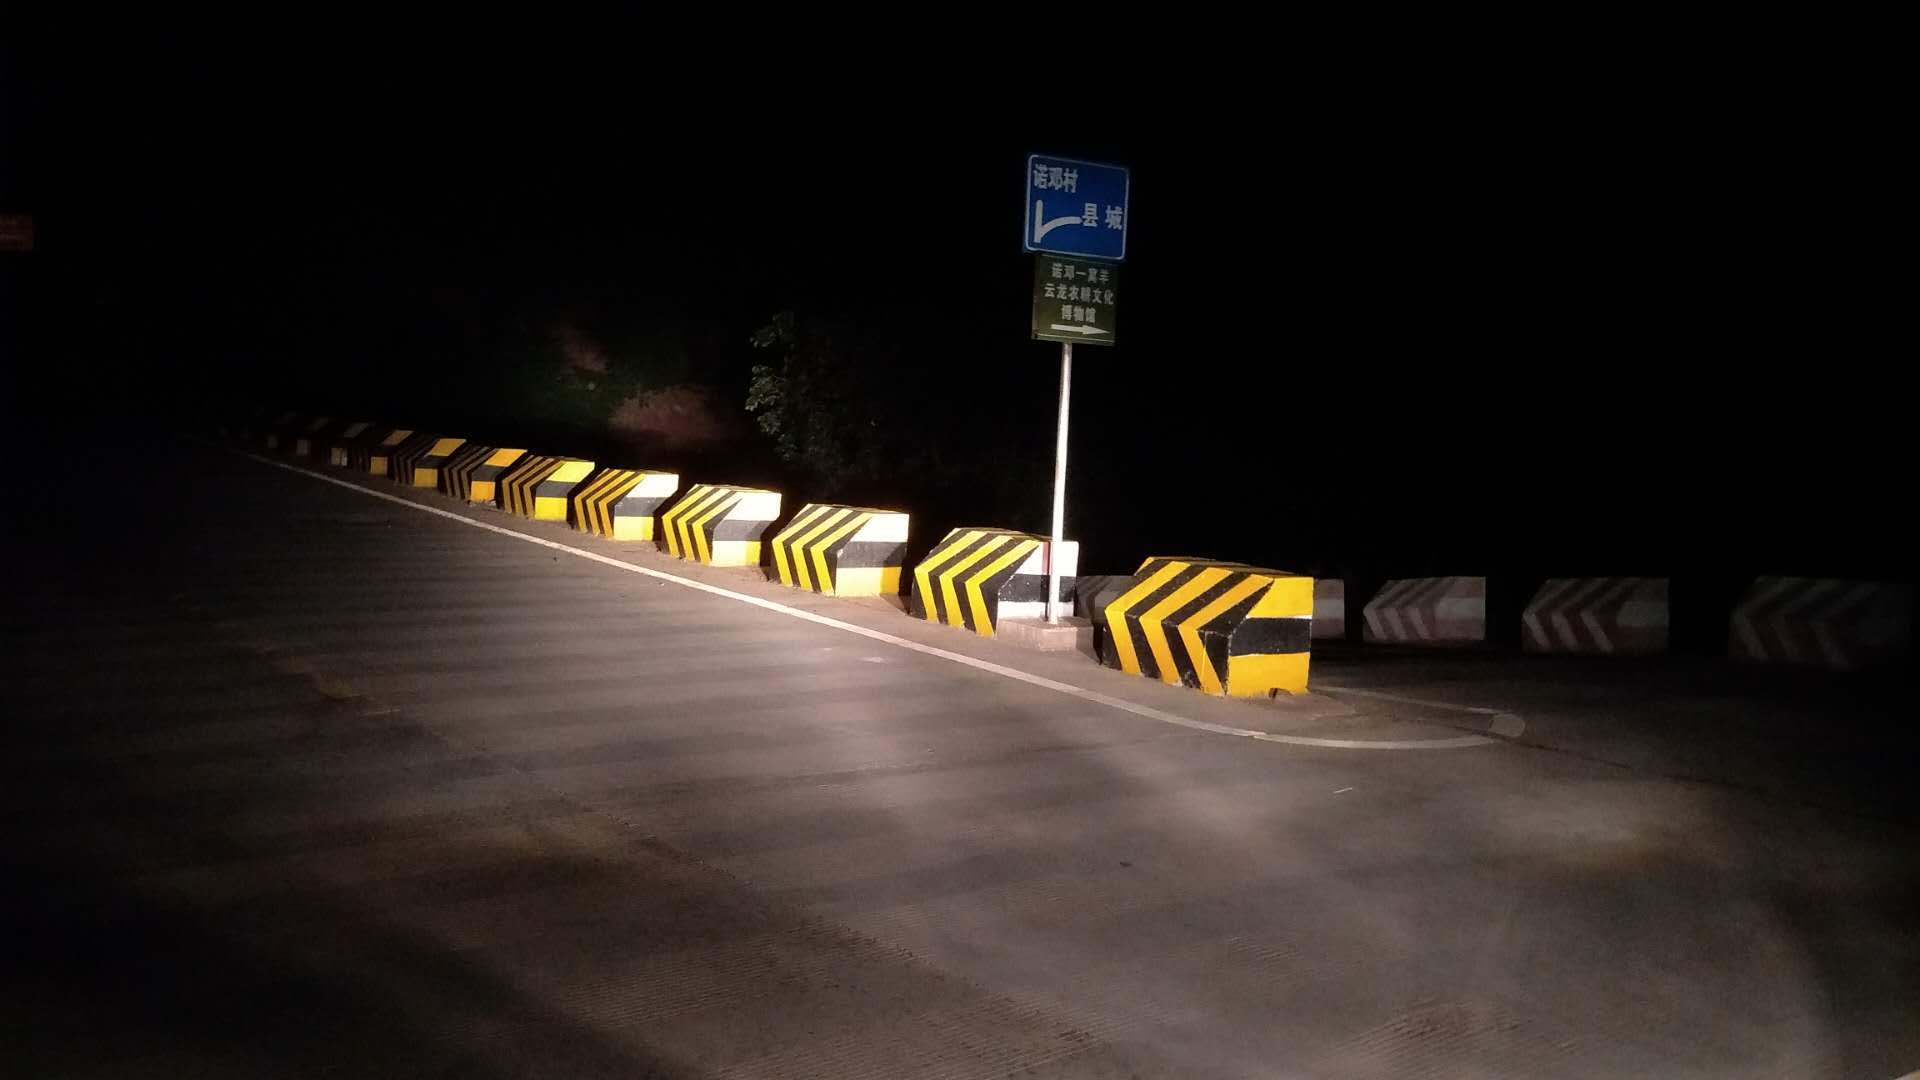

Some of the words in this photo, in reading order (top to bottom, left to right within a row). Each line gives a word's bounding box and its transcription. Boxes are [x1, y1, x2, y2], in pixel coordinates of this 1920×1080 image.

[1033, 164, 1078, 193] 诺邓村
[1082, 203, 1123, 230] 县城
[1044, 283, 1114, 305] 云龙农耕文化
[1061, 305, 1096, 323] 博物馆
